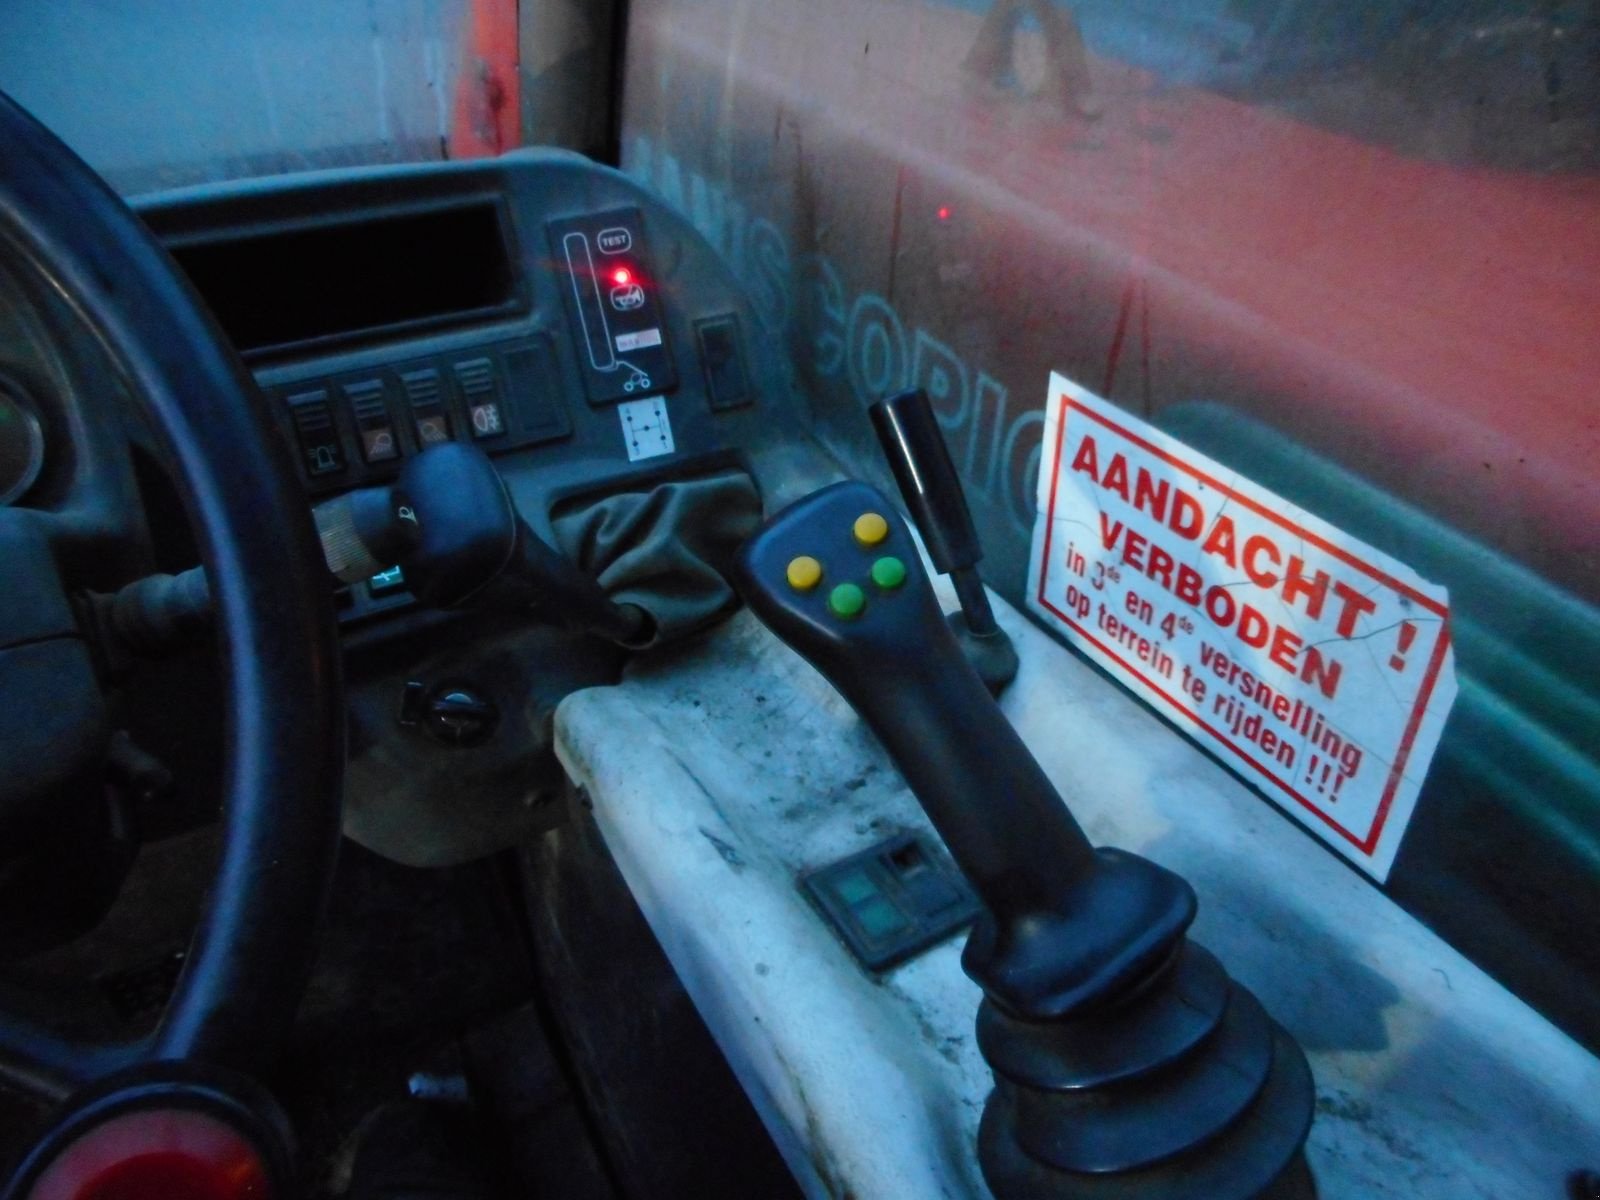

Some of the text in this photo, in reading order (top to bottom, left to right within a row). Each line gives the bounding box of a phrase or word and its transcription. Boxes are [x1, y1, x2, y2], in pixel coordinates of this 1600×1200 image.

[602, 234, 627, 247] TEST
[1066, 541, 1086, 578] in
[1125, 590, 1154, 626] en
[1200, 641, 1363, 780] versnelling
[1071, 434, 1418, 673] AANDACHT !
[1098, 511, 1343, 700] VERBODEN
[1066, 584, 1346, 804] op terrein te rijden !!!
